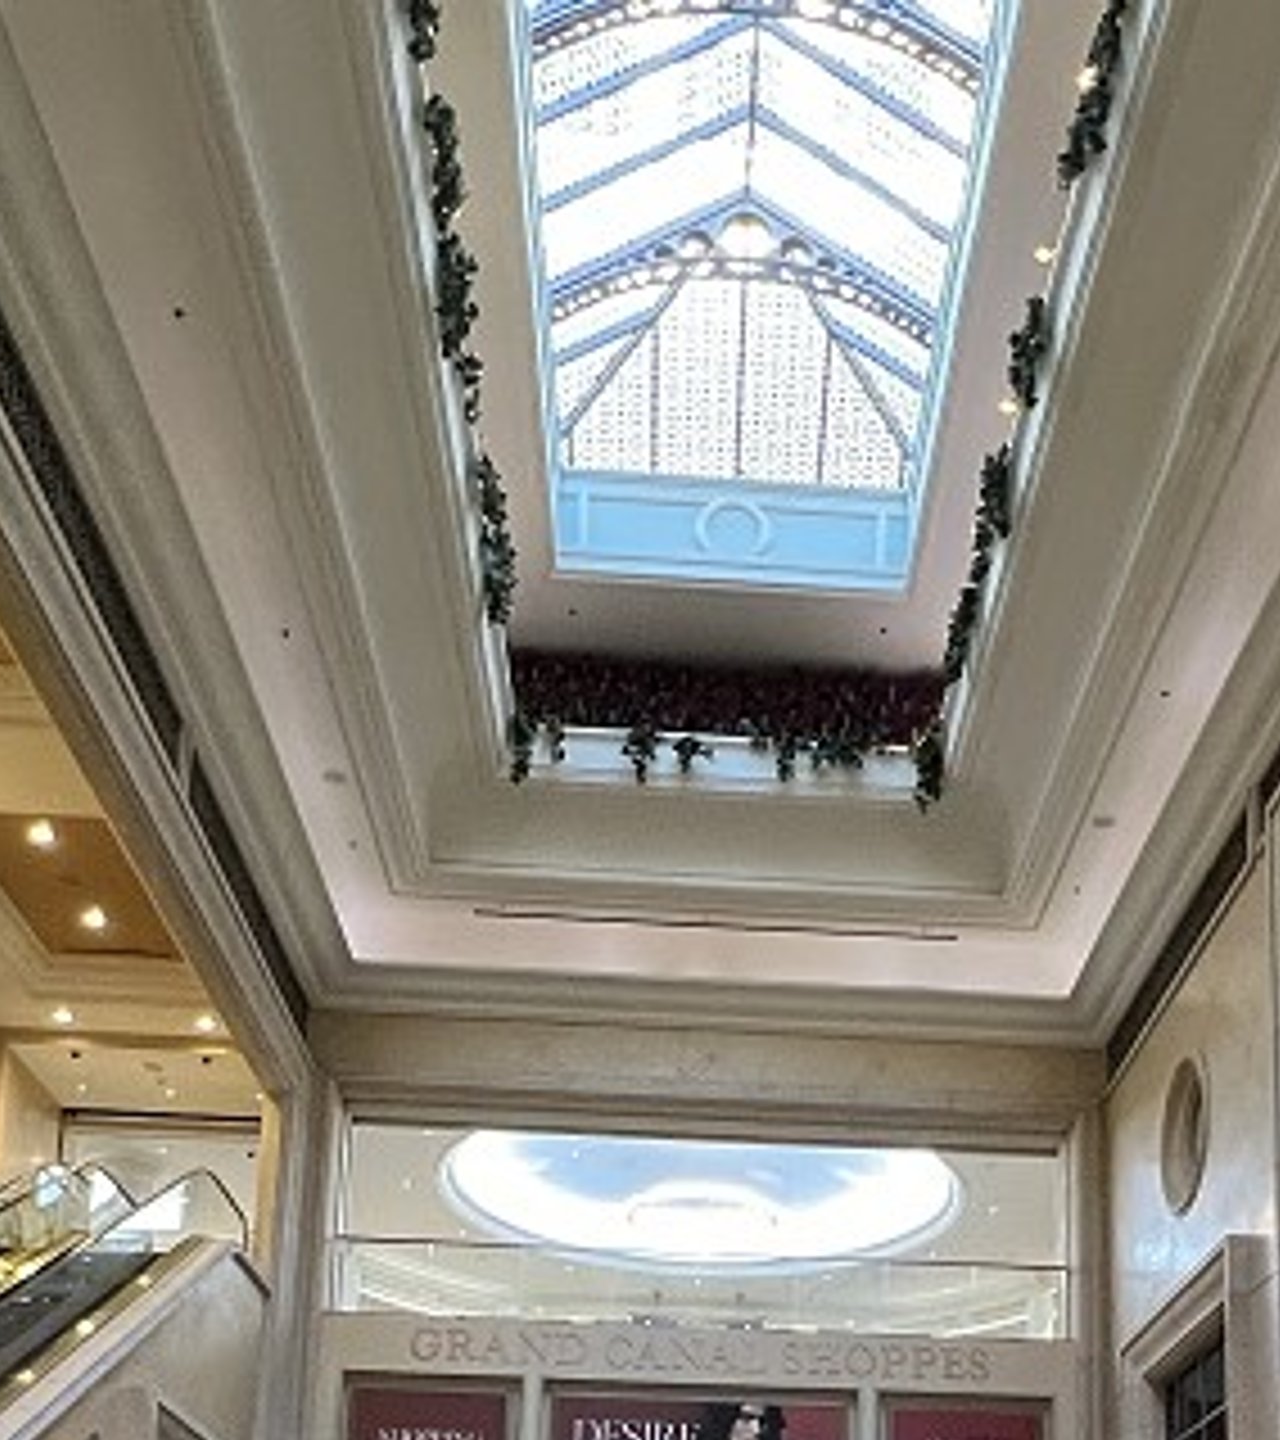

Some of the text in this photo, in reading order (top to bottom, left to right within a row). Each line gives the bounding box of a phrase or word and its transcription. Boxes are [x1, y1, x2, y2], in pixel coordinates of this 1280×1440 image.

[410, 1327, 990, 1381] GRAND CANAL SHOPPES
